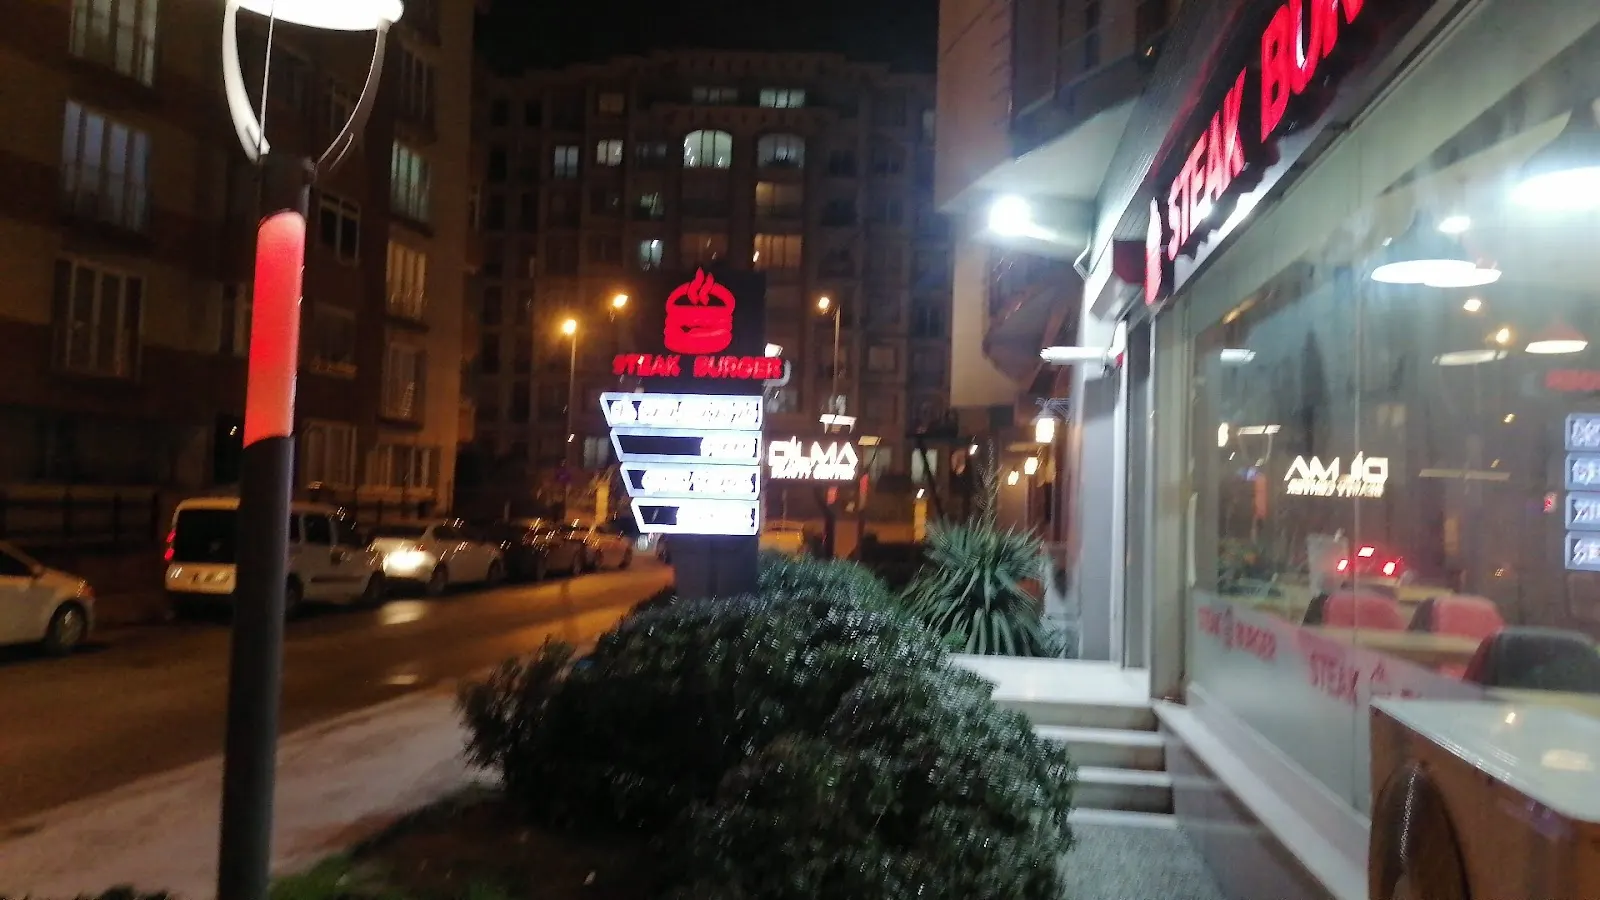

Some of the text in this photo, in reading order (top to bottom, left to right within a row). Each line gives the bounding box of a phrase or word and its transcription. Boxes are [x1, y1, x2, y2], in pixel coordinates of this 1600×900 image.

[1168, 66, 1246, 261] STEAK
[612, 354, 782, 380] STEAK BURGER
